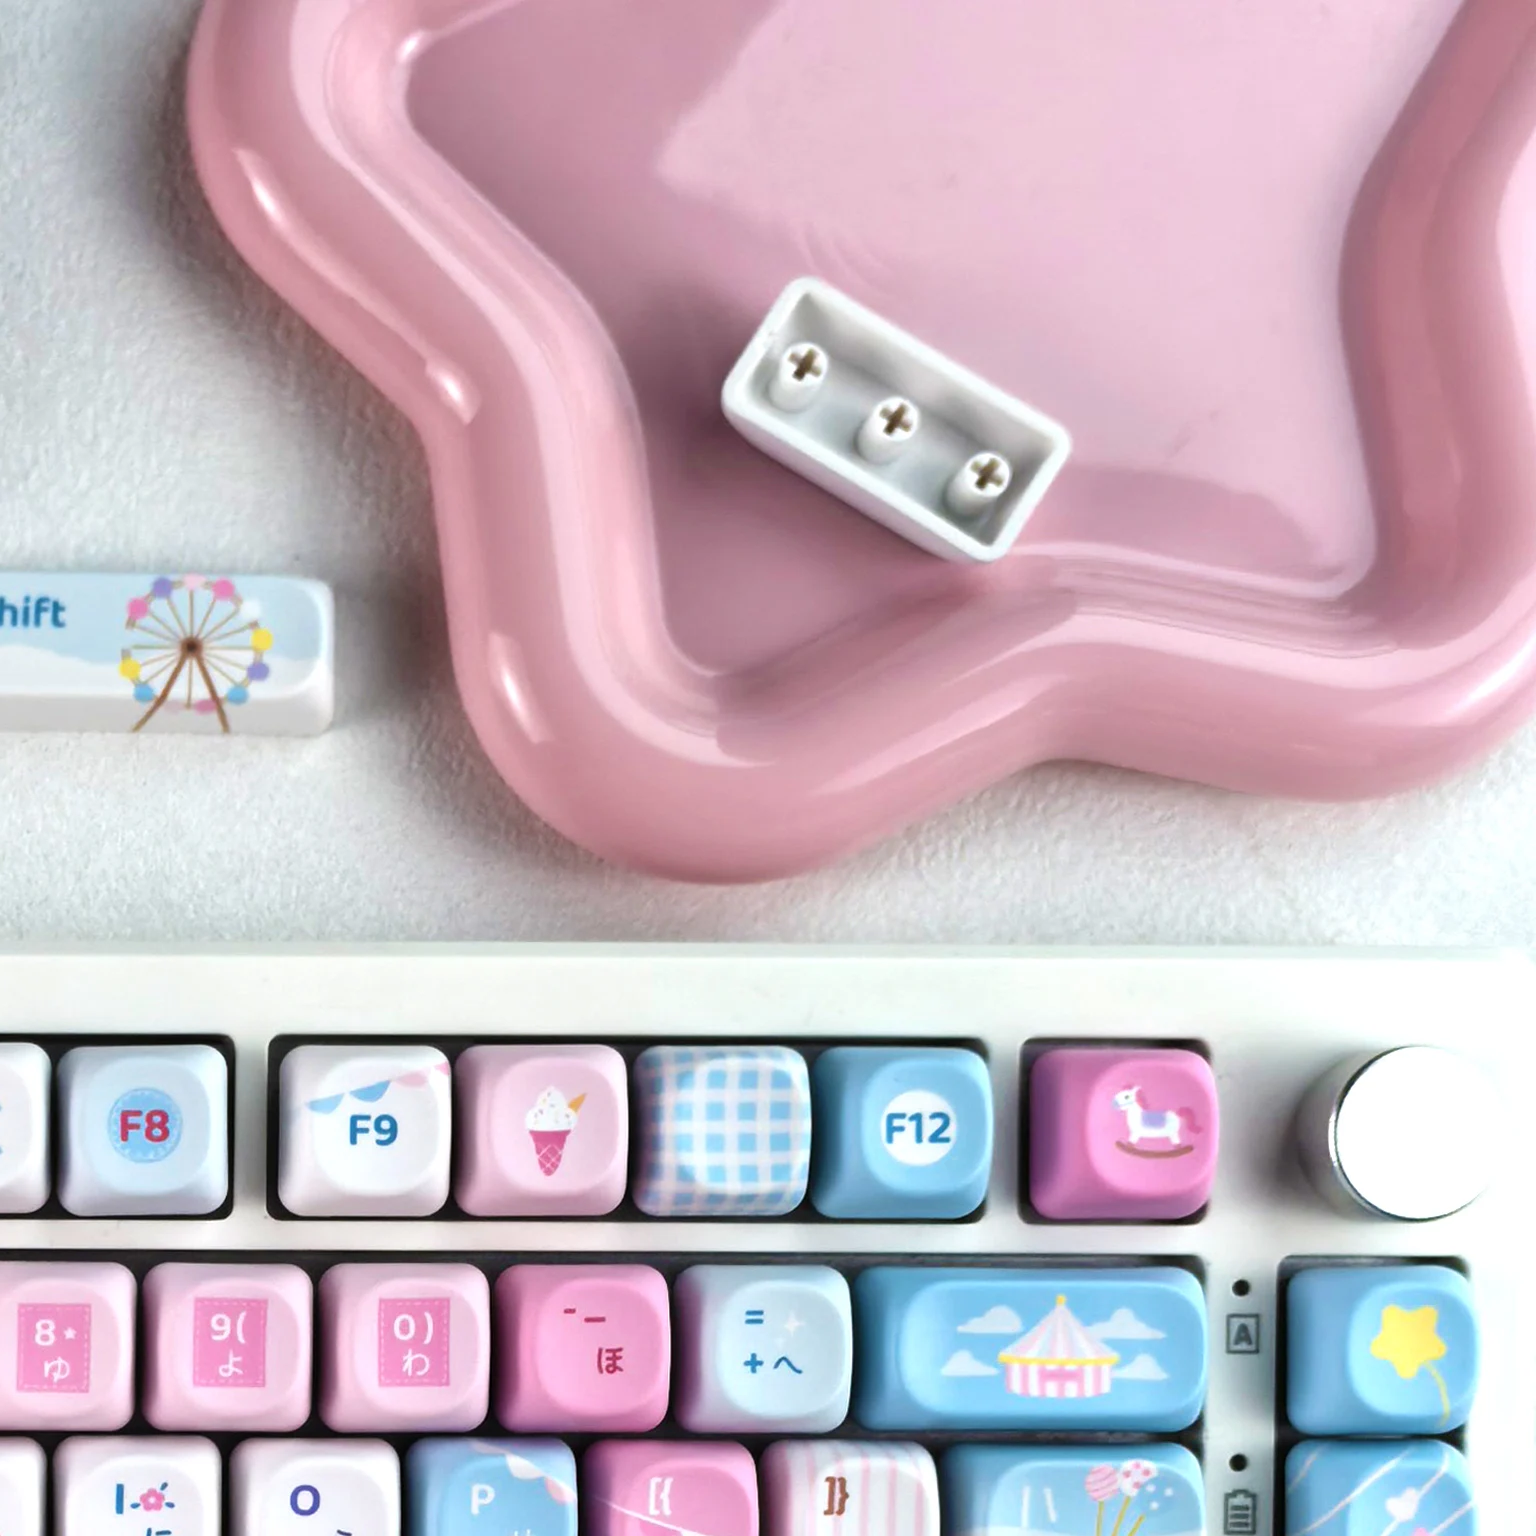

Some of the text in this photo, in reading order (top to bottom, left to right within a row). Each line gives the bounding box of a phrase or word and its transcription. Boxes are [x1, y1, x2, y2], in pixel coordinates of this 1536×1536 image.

[118, 1108, 171, 1143] F8
[348, 1112, 399, 1148] F9
[885, 1110, 952, 1146] F12
[209, 1311, 248, 1345] 9(
[392, 1311, 435, 1345] 0)
[1232, 1322, 1254, 1346] A
[42, 1355, 71, 1383] ゆ
[218, 1351, 244, 1379] よ
[402, 1348, 431, 1377] わ
[596, 1346, 625, 1375] ほ
[114, 1482, 125, 1516] I
[288, 1483, 322, 1518] O
[470, 1483, 496, 1517] P
